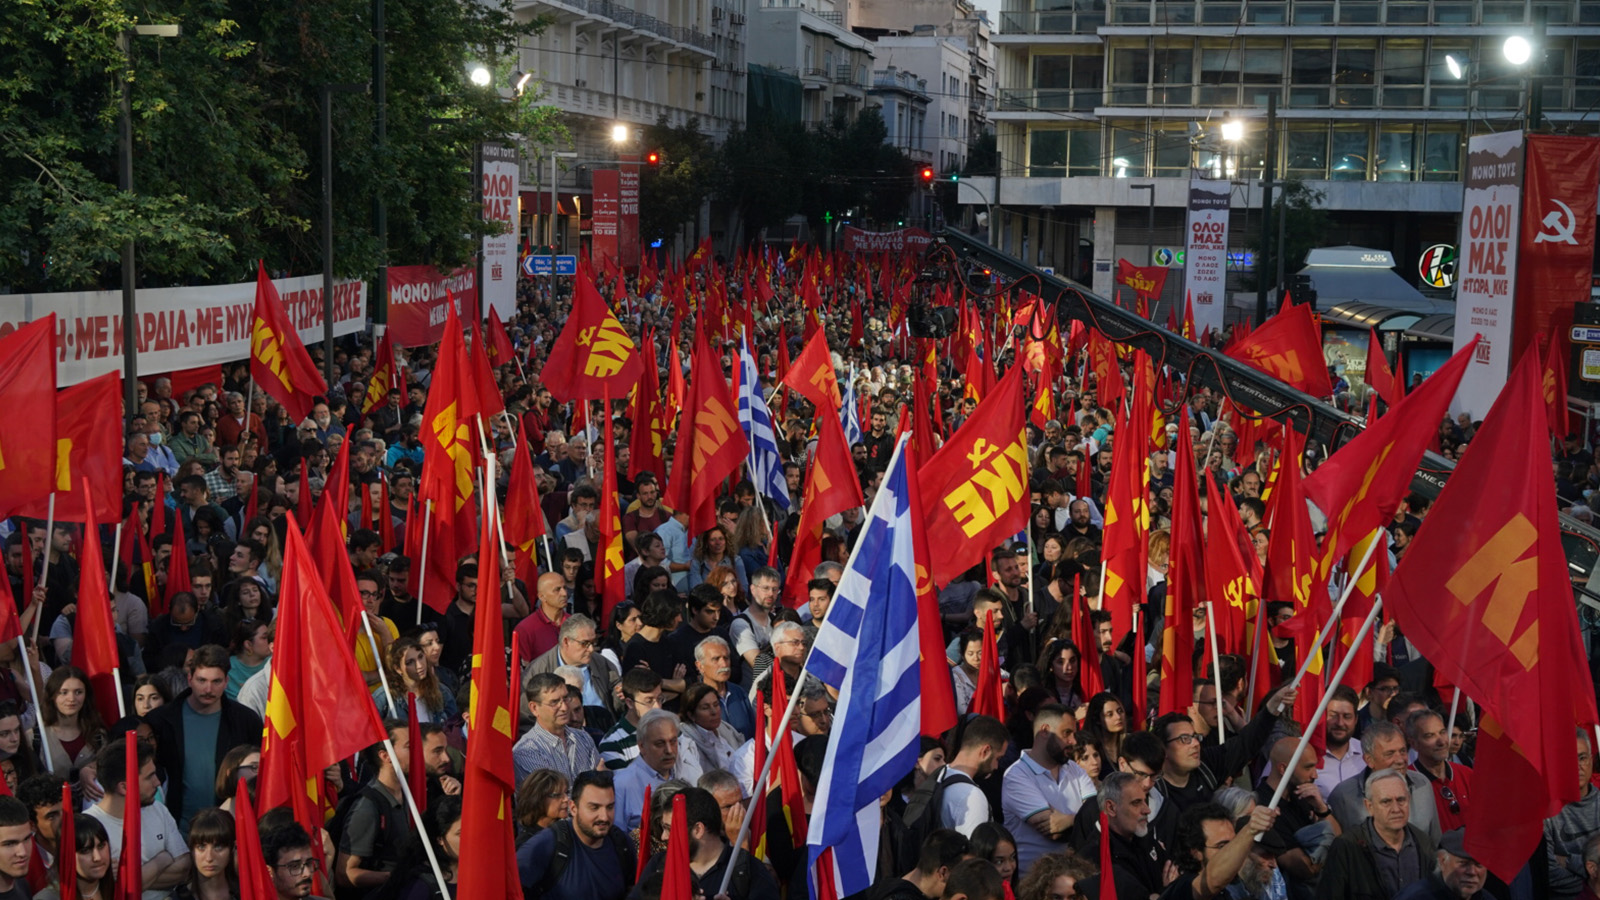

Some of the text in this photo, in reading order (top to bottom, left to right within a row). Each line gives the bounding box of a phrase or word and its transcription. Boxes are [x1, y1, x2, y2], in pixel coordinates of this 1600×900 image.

[1472, 162, 1516, 180] ΜΟΝΟΙ ΤΟΥΣ
[483, 173, 513, 197] ΟΛΟΙ
[483, 198, 512, 221] ΜΑΣ
[1192, 222, 1225, 233] ΟΛΟΙ
[1469, 204, 1512, 239] ΟΛΟΙ
[1193, 234, 1223, 244] ΜΑΣ
[1468, 241, 1508, 275] ΜΑΣ
[391, 282, 430, 305] ΜΟΝΟ
[1463, 277, 1508, 298] #ΤΩΡΑ_ΚΚΕ
[1197, 295, 1213, 303] ΚΚΕ
[75, 315, 109, 361] ΜΕ
[196, 306, 224, 347] ΜΕ
[1476, 343, 1491, 361] ΚΚΕ
